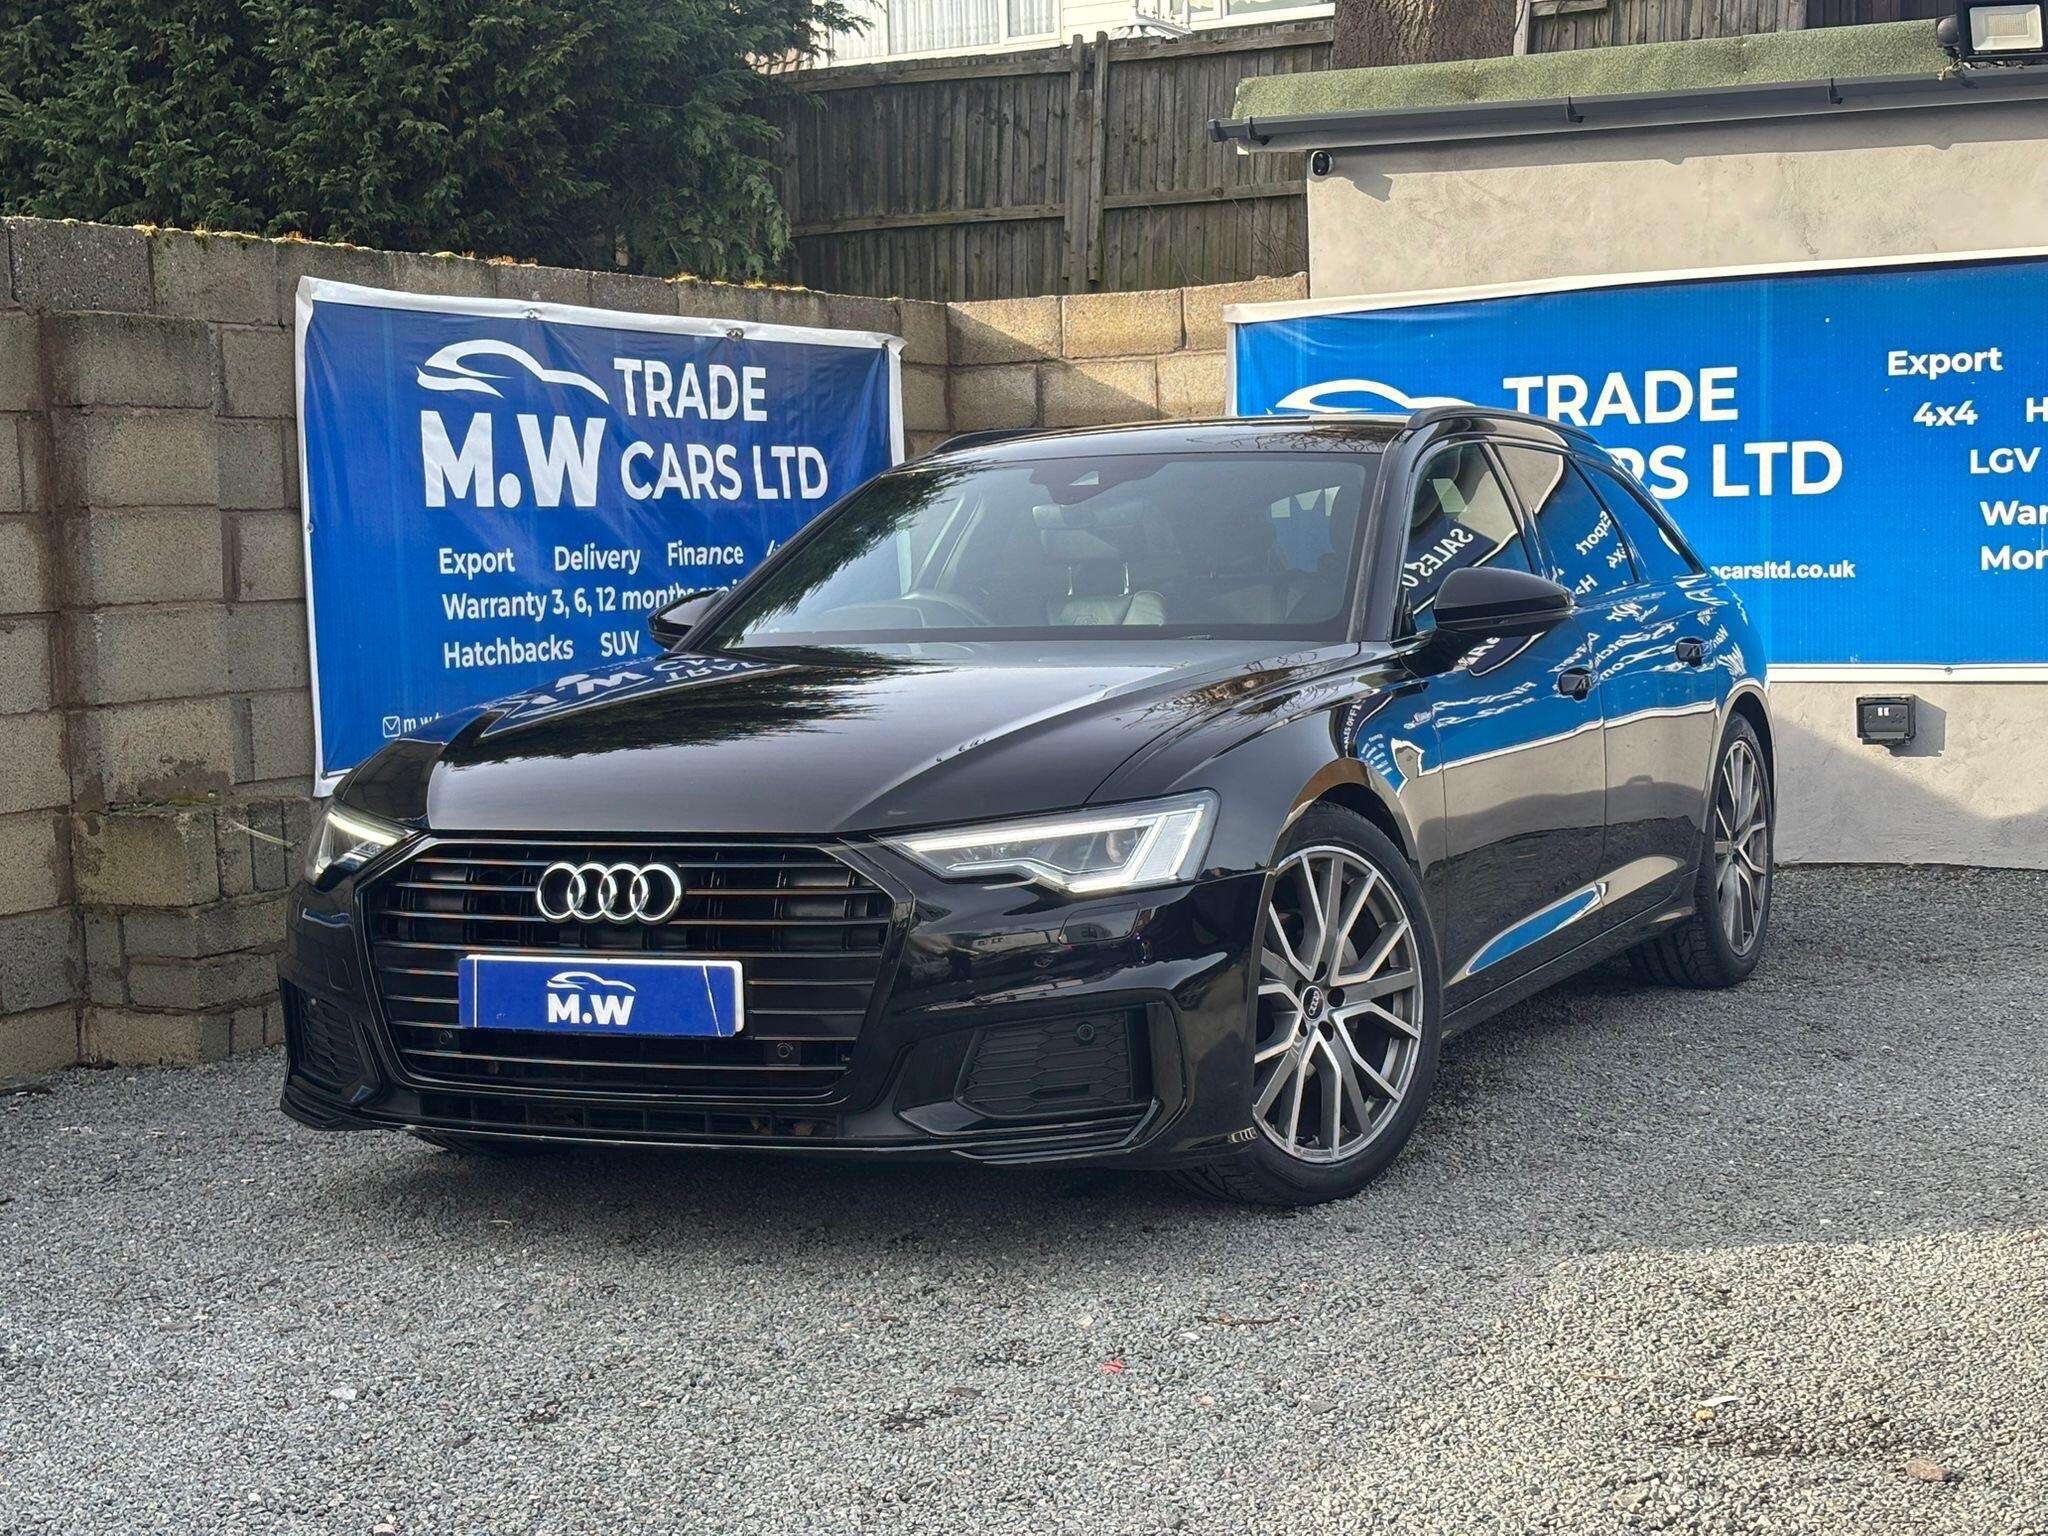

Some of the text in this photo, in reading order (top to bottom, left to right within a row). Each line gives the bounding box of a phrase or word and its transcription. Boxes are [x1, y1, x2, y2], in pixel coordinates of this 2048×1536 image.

[1888, 347, 2004, 380] Export
[613, 357, 769, 422] TRADE
[1503, 366, 1739, 427] TRADE
[1913, 400, 1979, 427] 4x4
[420, 410, 607, 508] M.W
[620, 441, 830, 501] CARS LTD
[1712, 440, 1843, 497] LTD
[1970, 447, 2041, 474] LGV
[439, 547, 516, 580] Export
[554, 542, 641, 575] Delivery
[667, 540, 745, 567] Finance
[442, 592, 547, 622] Warranty
[552, 588, 570, 619] 3,
[574, 587, 592, 617] 6,
[596, 586, 616, 612] 12
[444, 630, 640, 669] Hatchbacks SUV
[548, 993, 635, 1026] M.W
